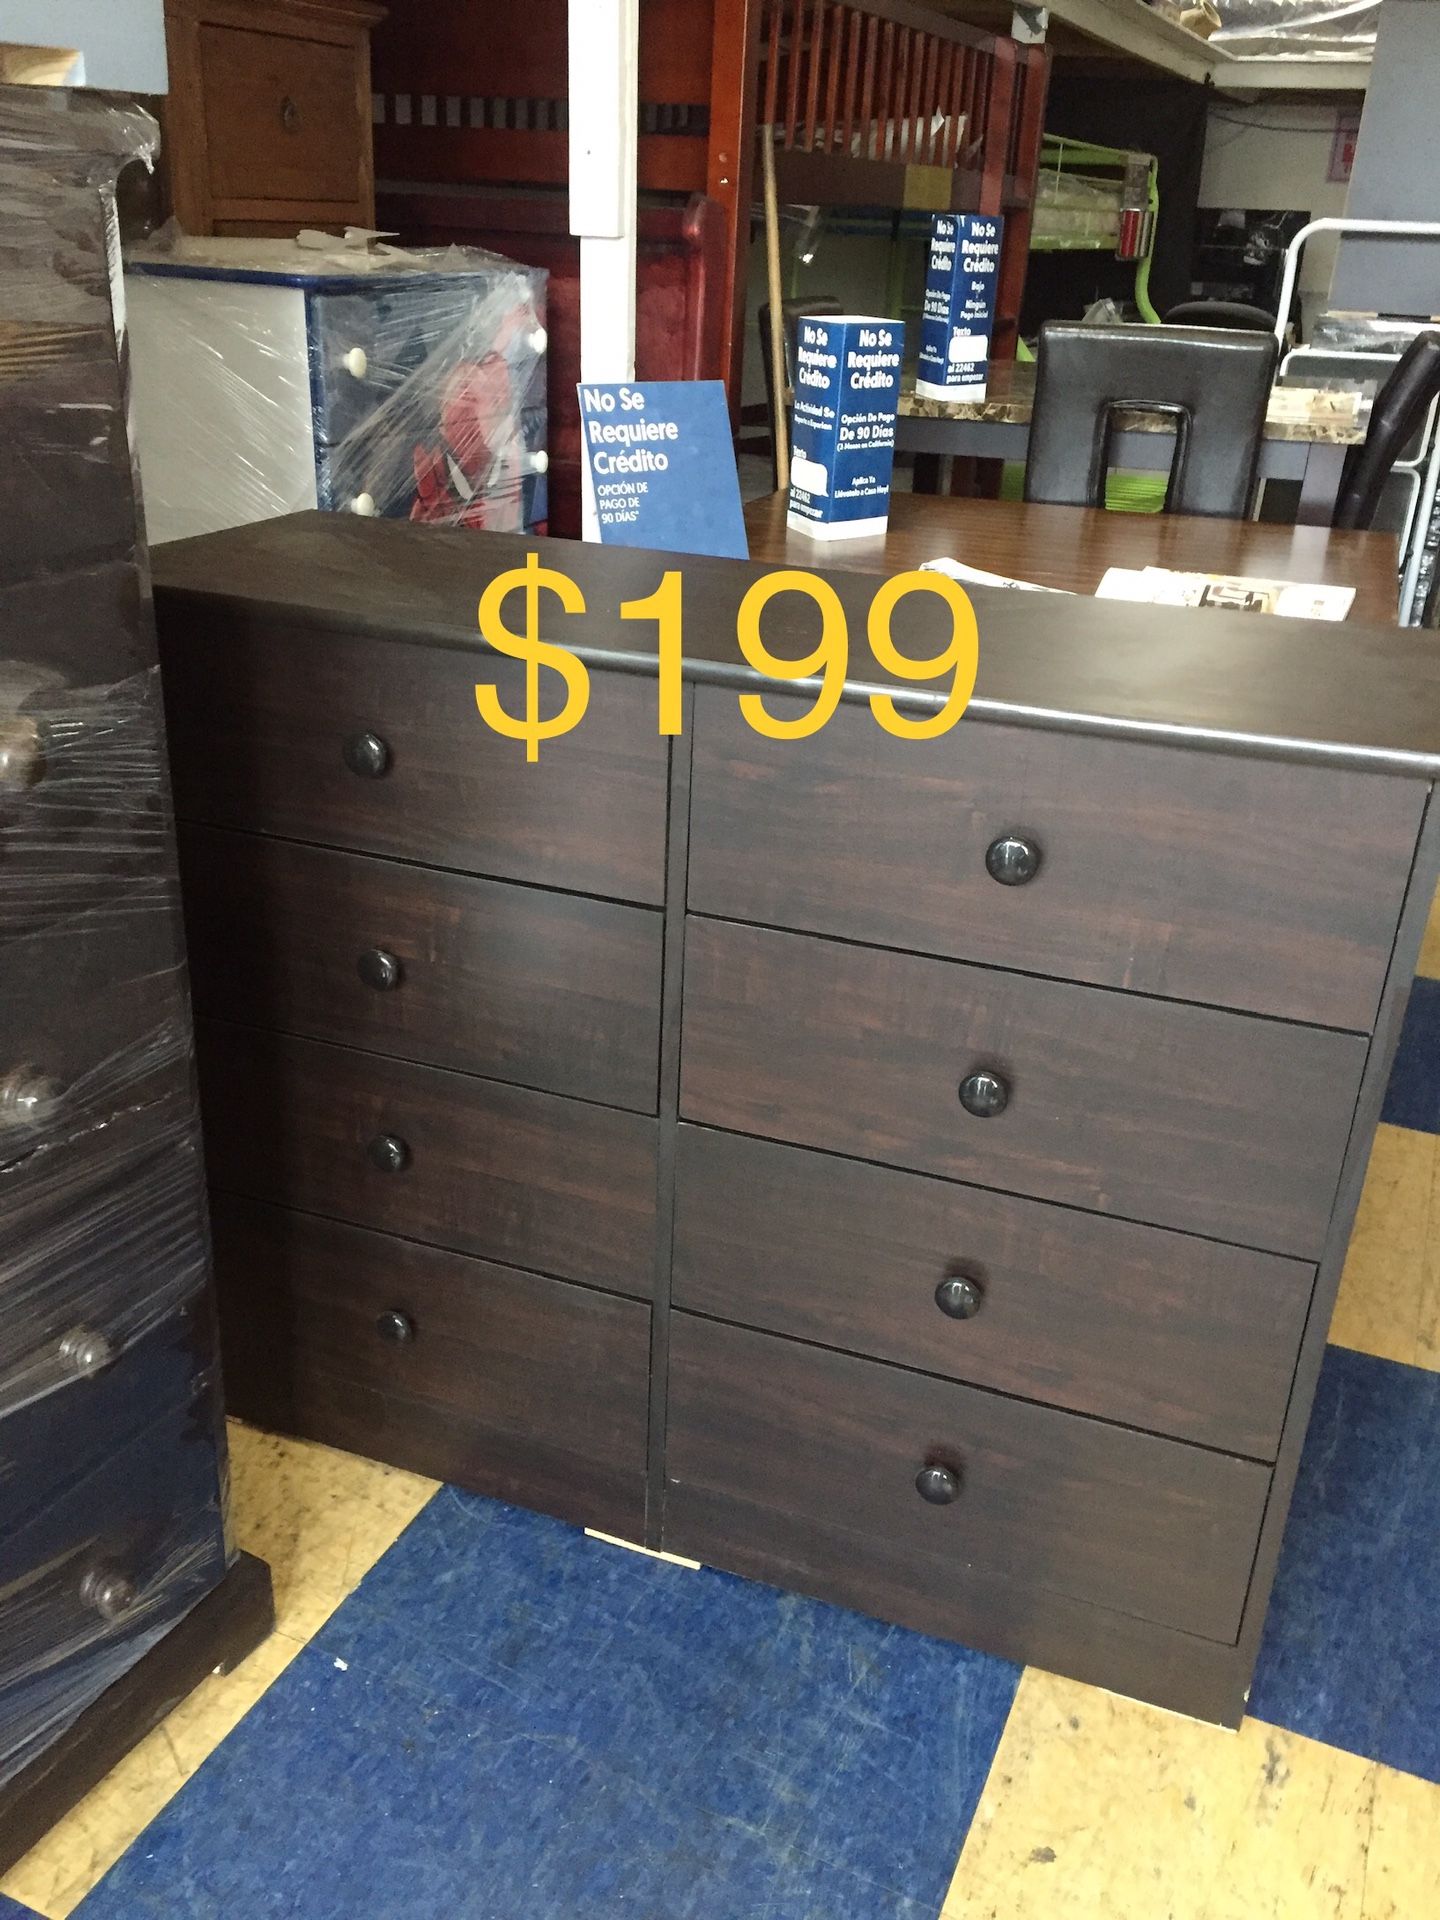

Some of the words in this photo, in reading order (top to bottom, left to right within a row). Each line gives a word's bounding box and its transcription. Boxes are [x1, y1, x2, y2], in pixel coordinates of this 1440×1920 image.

[972, 222, 985, 236] No
[986, 222, 996, 237] Se
[962, 240, 998, 257] Requiere
[804, 326, 816, 344] No
[816, 328, 828, 346] Se
[859, 329, 876, 347] No
[878, 329, 892, 347] Se
[798, 346, 838, 370] Requiere
[847, 350, 900, 371] Requiere
[850, 371, 894, 389] Crédito
[584, 388, 615, 412] No
[618, 388, 645, 410] Se
[878, 412, 895, 424] Pago
[588, 418, 678, 447] Requiere
[840, 427, 854, 440] De
[857, 426, 870, 440] 90
[872, 424, 894, 438] Días
[594, 449, 668, 474] Crédito
[597, 480, 635, 496] OPCIÓN
[636, 482, 648, 494] DE
[599, 498, 627, 510] PAGO
[628, 497, 640, 508] DE
[601, 512, 614, 524] 90
